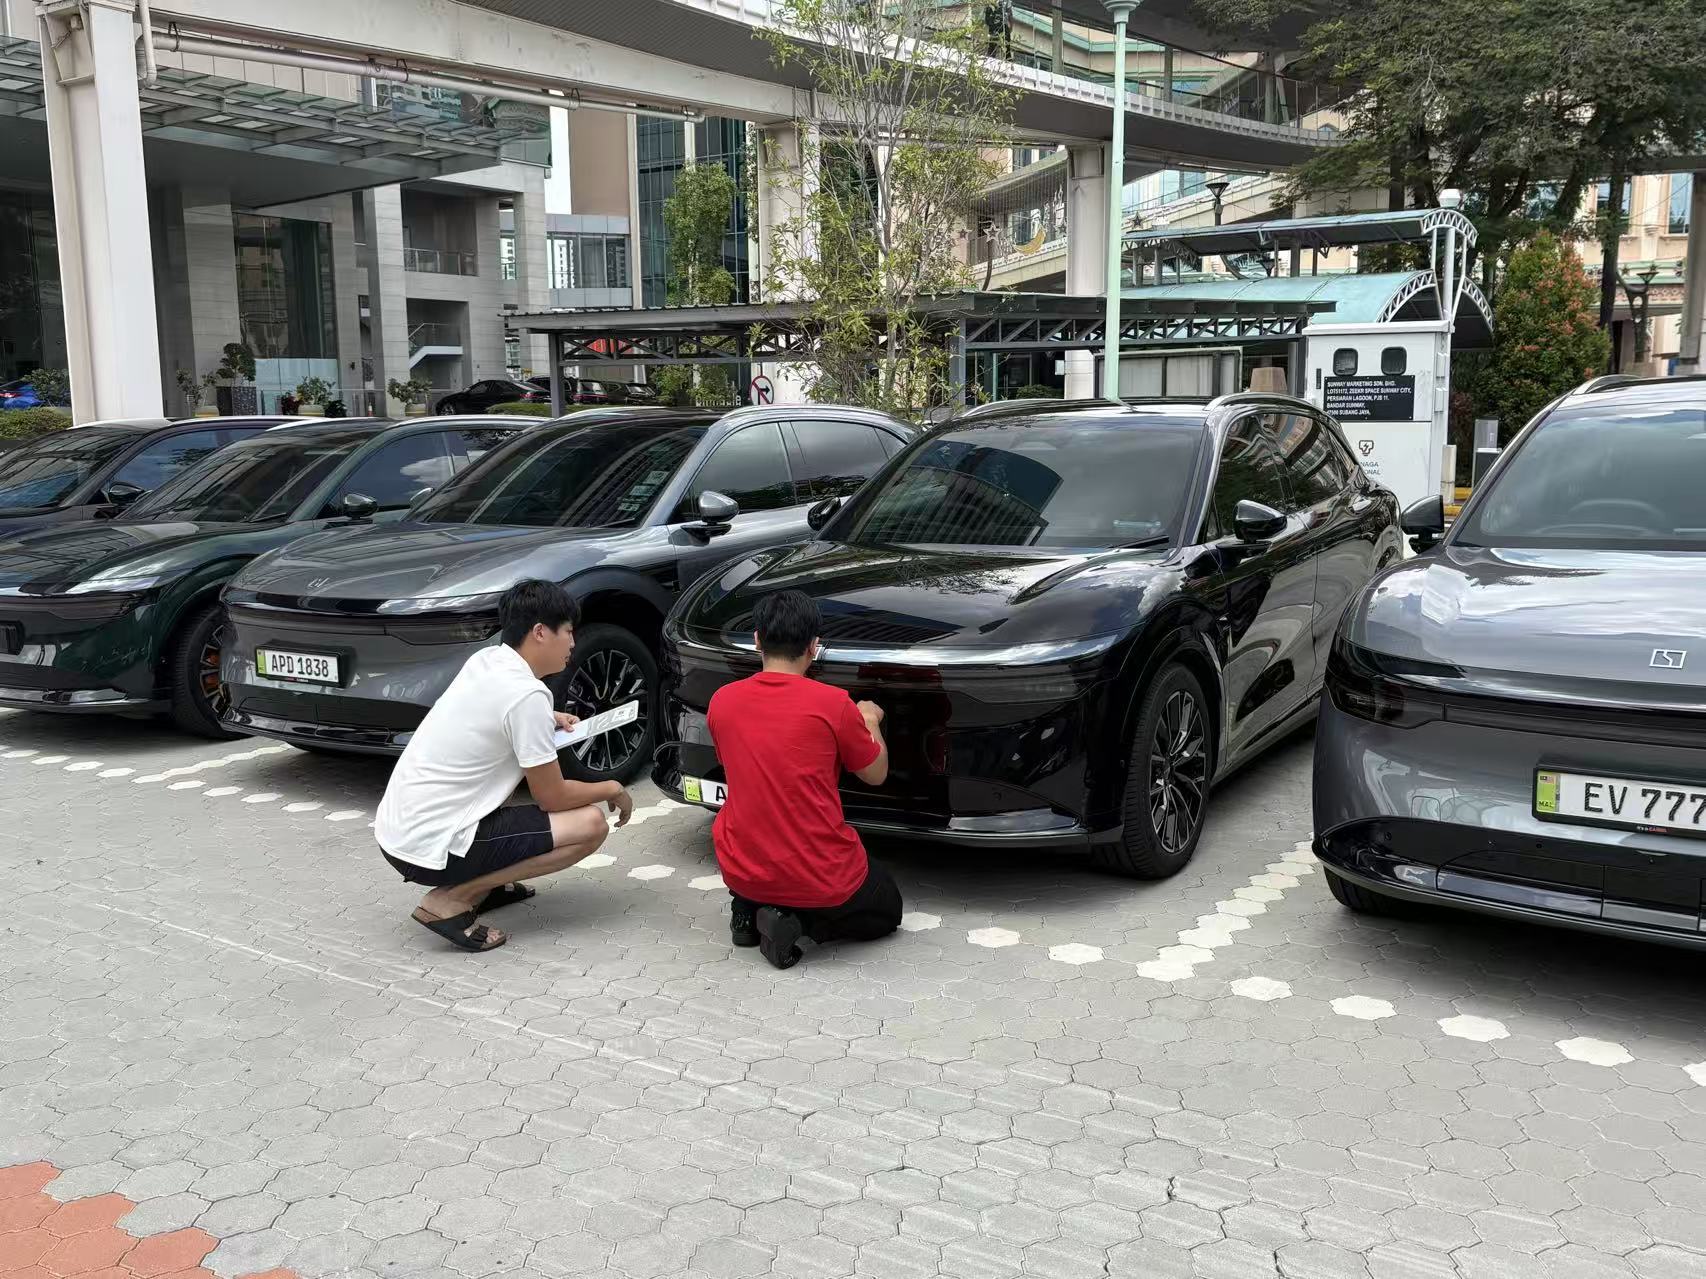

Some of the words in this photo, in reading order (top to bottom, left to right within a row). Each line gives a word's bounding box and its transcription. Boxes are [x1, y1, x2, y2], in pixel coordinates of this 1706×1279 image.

[272, 654, 294, 673] APD
[297, 657, 329, 677] 1838
[1538, 800, 1555, 808] MAL
[1584, 782, 1628, 815] EV
[1641, 788, 1706, 824] 777
